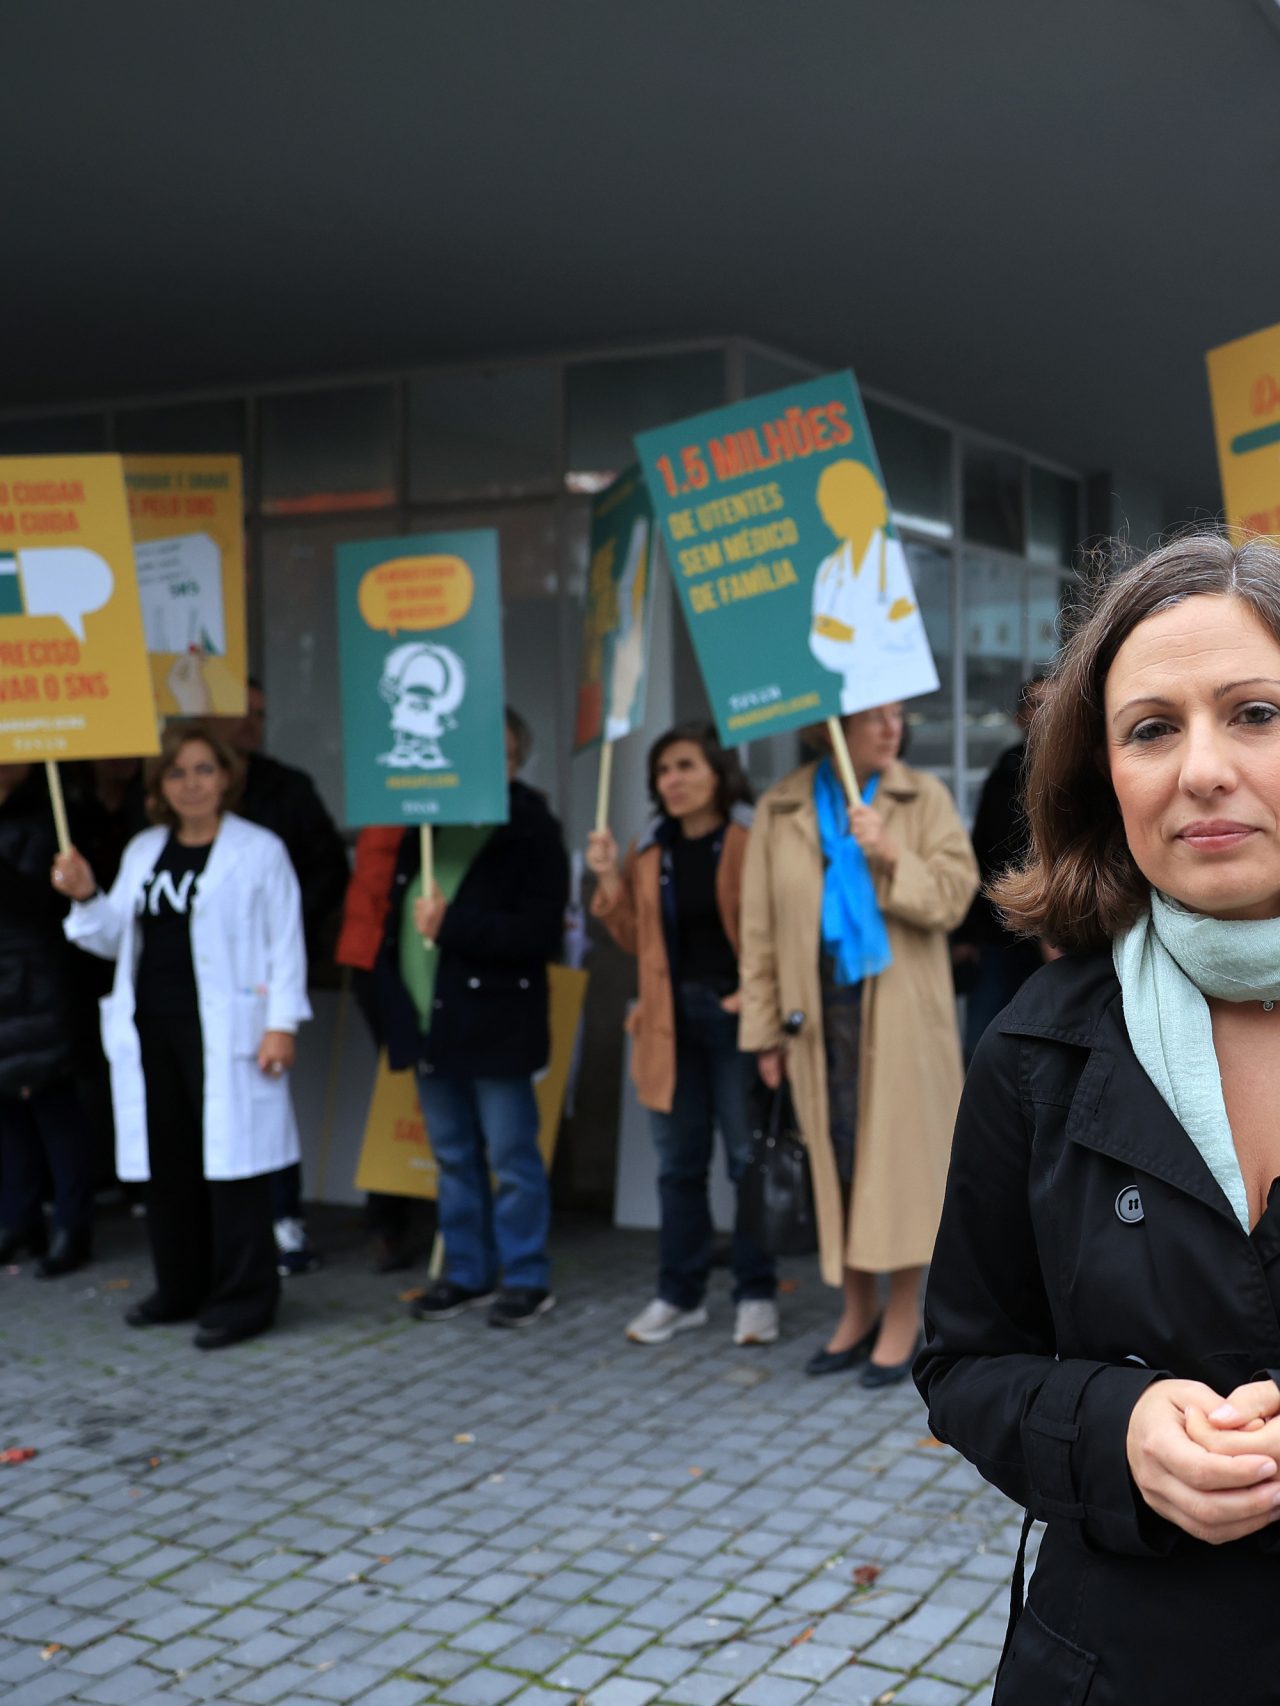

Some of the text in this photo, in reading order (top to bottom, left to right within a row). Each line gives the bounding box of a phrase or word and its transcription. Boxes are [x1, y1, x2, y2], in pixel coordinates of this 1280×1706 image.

[656, 402, 853, 498] 1.5 MILHÕES
[668, 482, 785, 541] DE UTENTES
[678, 517, 800, 577] SEM MÉDICO
[688, 559, 798, 613] DE FAMÍLIA
[64, 671, 109, 701] SNS
